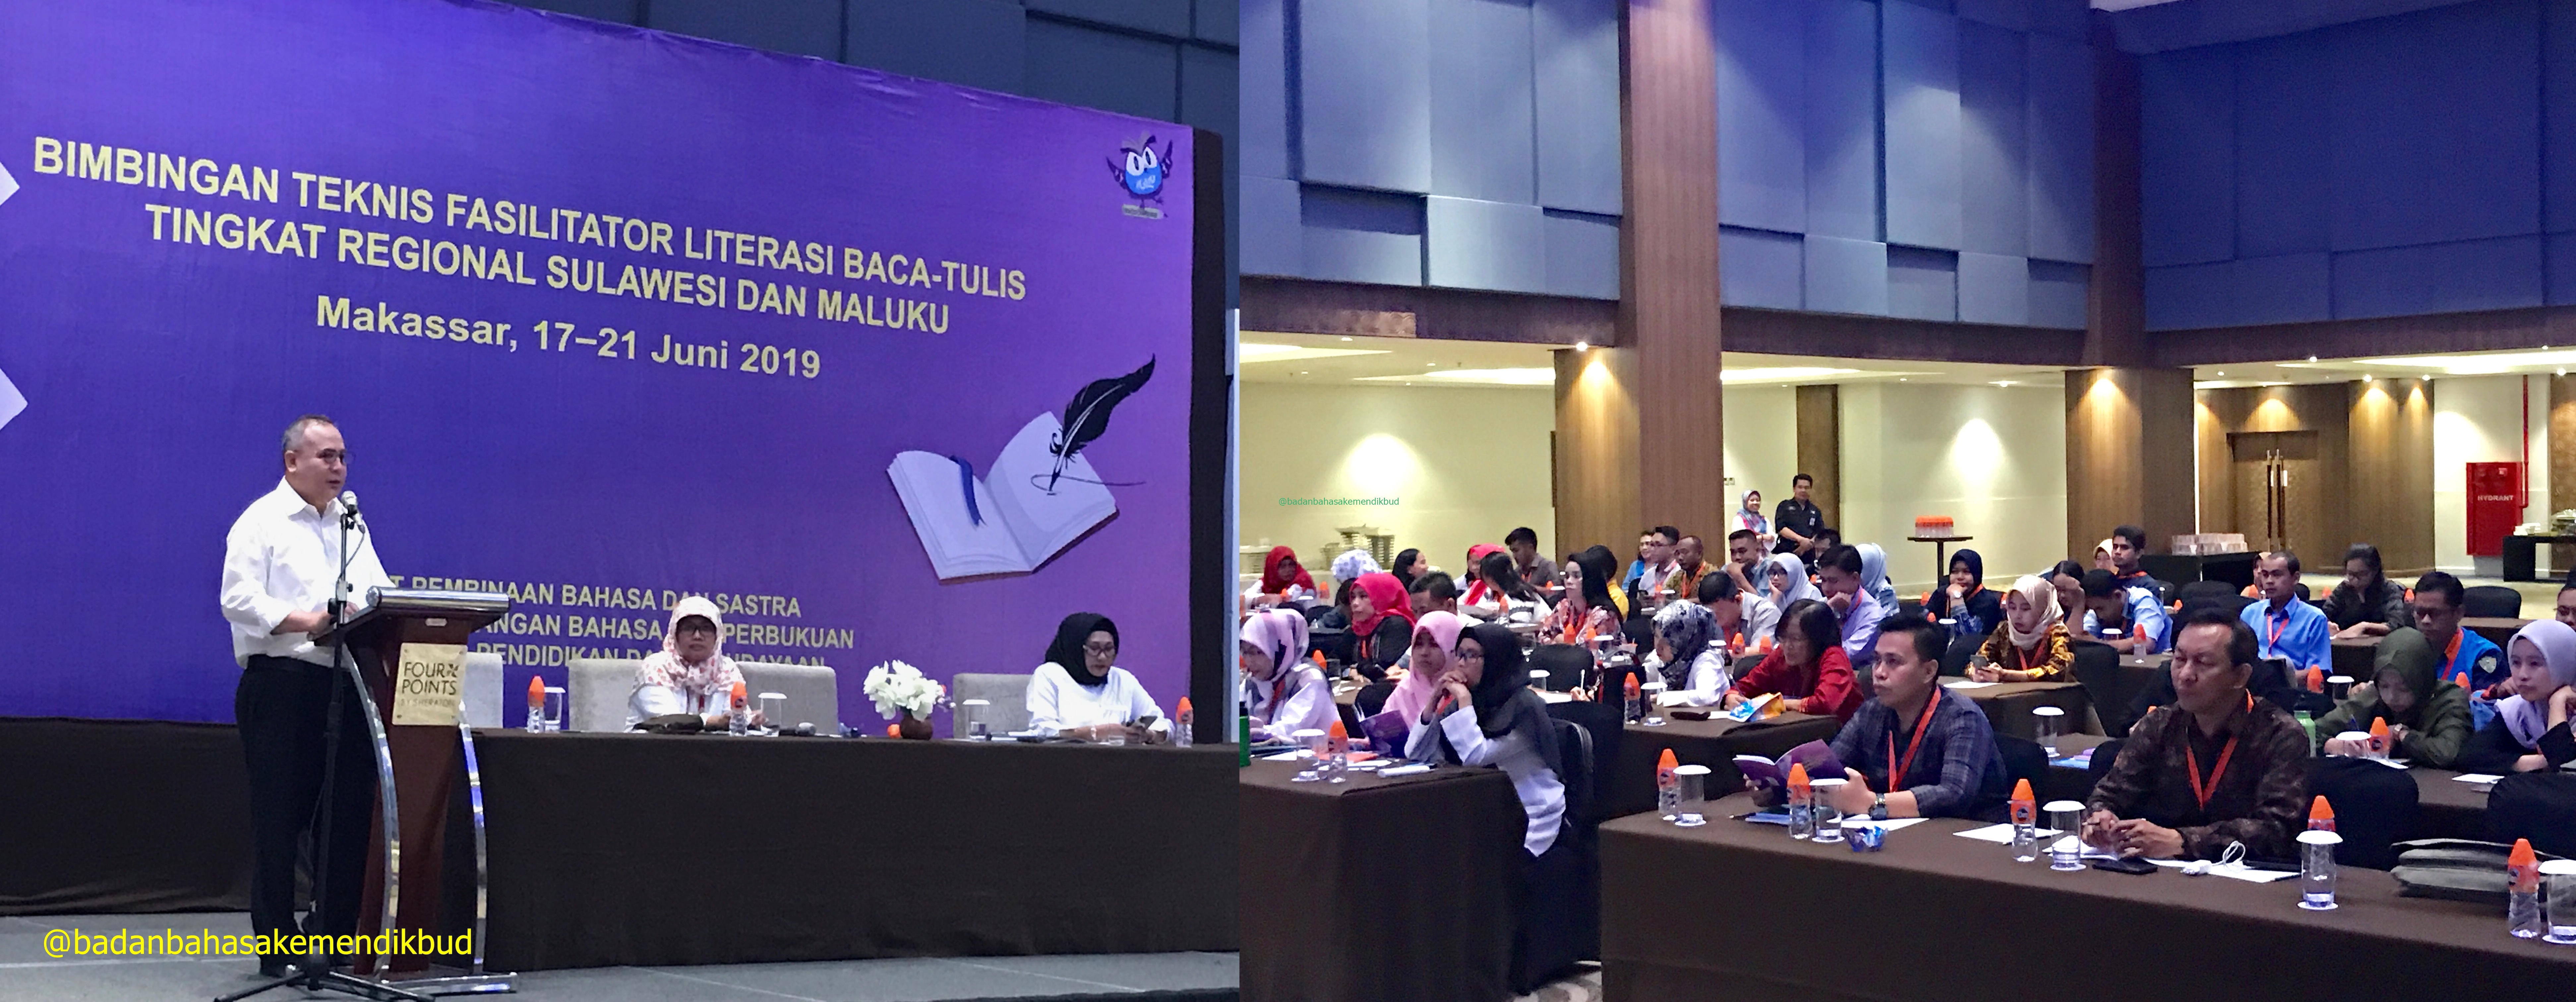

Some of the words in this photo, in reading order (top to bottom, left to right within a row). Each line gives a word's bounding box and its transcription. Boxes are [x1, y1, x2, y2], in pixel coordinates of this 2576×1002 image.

[34, 137, 278, 202] BIMBINGAN
[292, 172, 433, 223] TEKNIS
[447, 194, 673, 254] FASILITATOR
[685, 227, 833, 274] LITERASI
[844, 248, 1026, 300] BACA-TULIS
[146, 204, 326, 257] TINGKAT
[338, 228, 535, 284] REGIONAL
[547, 255, 725, 307] SULAWESI
[737, 279, 806, 316] DAN
[818, 289, 949, 333] MALUKU
[317, 295, 517, 353] Makassar,
[651, 334, 728, 368] Juni
[740, 343, 820, 378] 2019
[562, 584, 657, 610] BAHASA
[716, 593, 801, 617] SASTRA
[568, 615, 663, 641] BAHASA
[722, 623, 854, 648] PERBUKUAN
[404, 662, 446, 678] FOUR
[402, 679, 457, 695] POINTS
